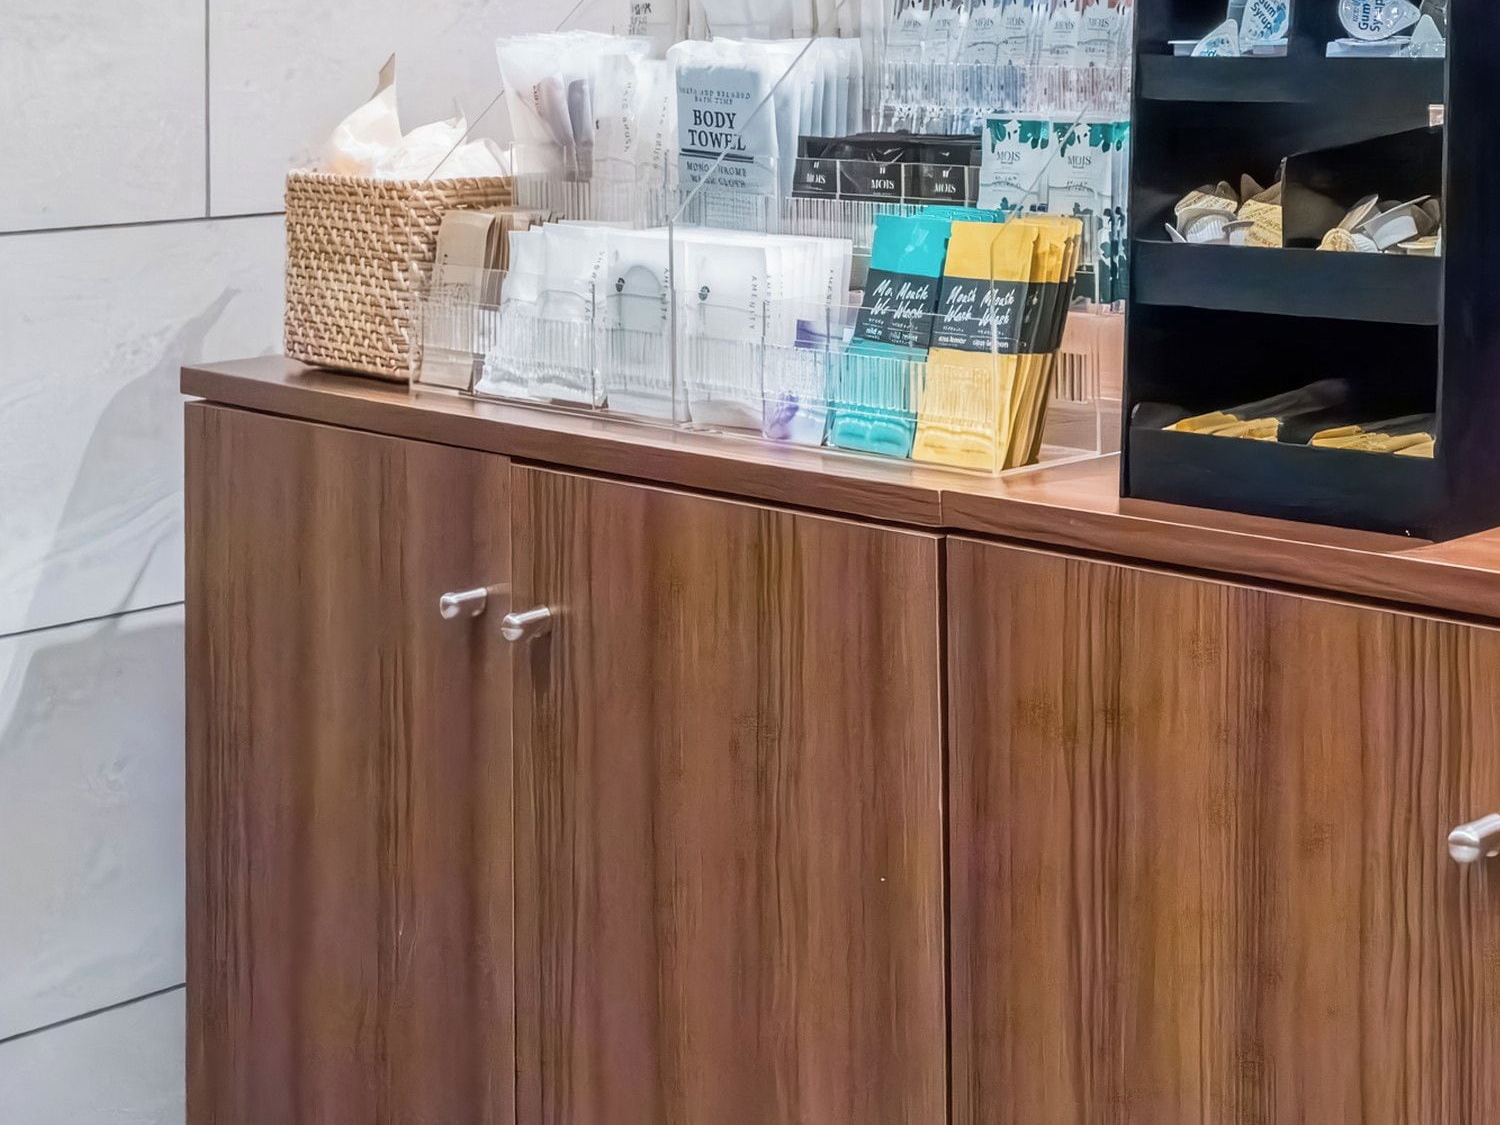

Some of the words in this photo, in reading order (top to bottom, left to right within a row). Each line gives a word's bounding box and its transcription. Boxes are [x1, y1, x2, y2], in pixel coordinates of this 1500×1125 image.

[1251, 2, 1274, 34] Syrup
[1359, 3, 1371, 31] Gum
[693, 109, 737, 129] BODY
[688, 129, 746, 151] TOWEL
[686, 161, 747, 177] MONOHROME
[871, 178, 895, 190] MOIS
[935, 182, 957, 194] MOIS
[896, 282, 929, 300] Mouth
[946, 285, 976, 305] Mouth
[749, 275, 758, 330] AMENITY
[944, 305, 973, 322] Wash
